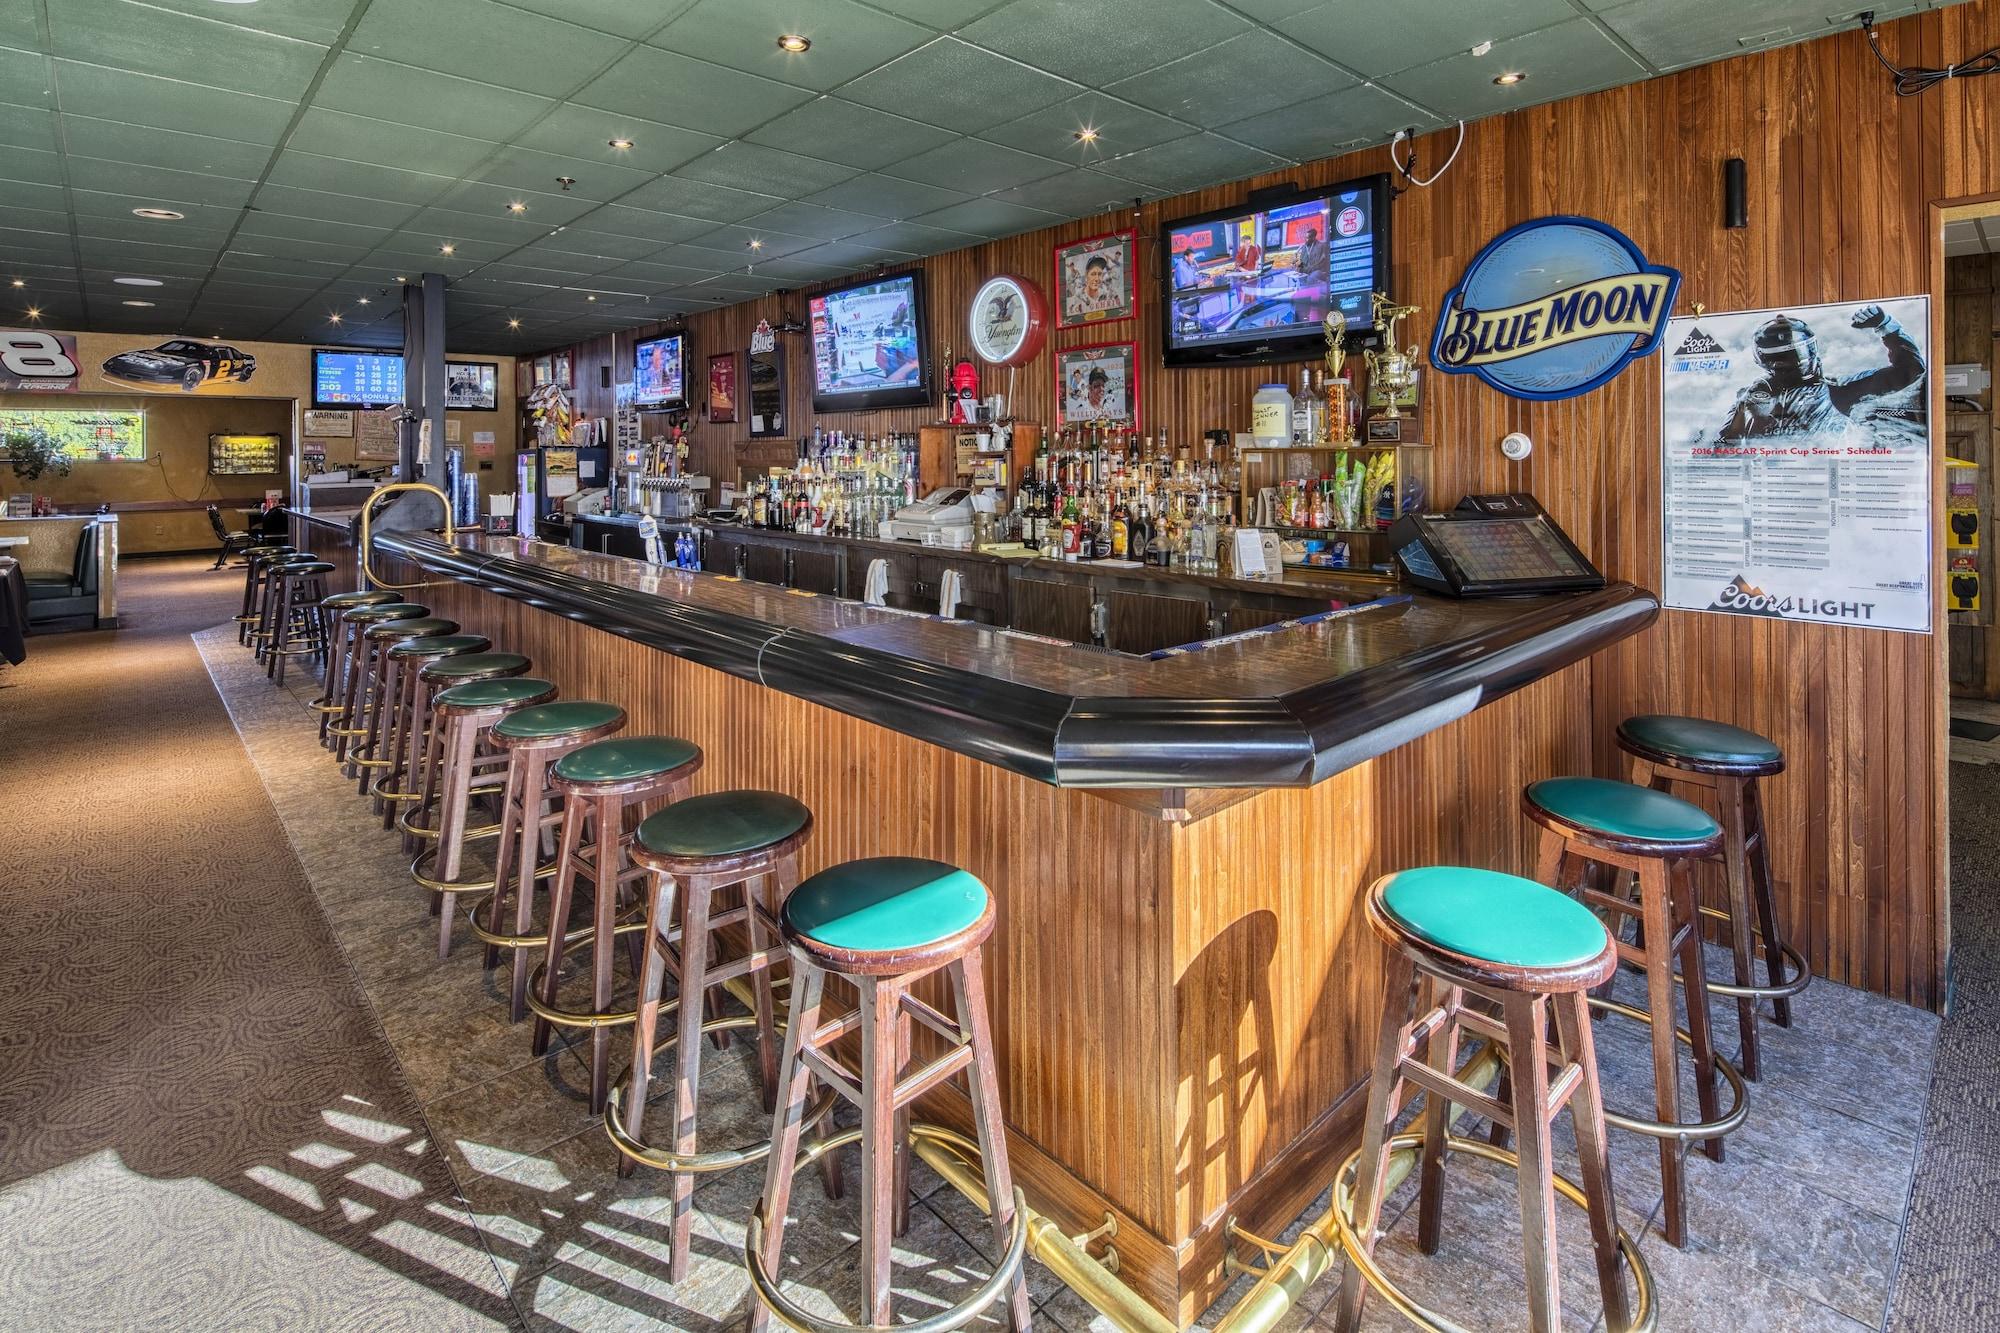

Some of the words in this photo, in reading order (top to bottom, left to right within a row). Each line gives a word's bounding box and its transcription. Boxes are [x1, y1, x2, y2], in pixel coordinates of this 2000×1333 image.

[1440, 308, 1543, 366] BLUE
[1543, 283, 1662, 340] MOON
[984, 324, 1025, 343] Yuenglin
[752, 334, 773, 351] Blue
[1680, 335, 1718, 348] Coors
[0, 332, 77, 377] 8
[1687, 345, 1712, 353] LIGHT
[215, 360, 231, 379] 2
[1688, 359, 1730, 371] NASCAR
[17, 382, 70, 390] RACING
[312, 411, 349, 420] WARNING
[959, 438, 978, 447] NOTIC
[1691, 446, 1713, 456] 2016
[1714, 446, 1757, 456] NASCAR
[1759, 446, 1787, 458] Sprint
[1790, 446, 1809, 458] Cup
[1847, 446, 1893, 456] Schedule
[1714, 583, 1795, 614] Coors
[1798, 597, 1877, 620] LIGHT
